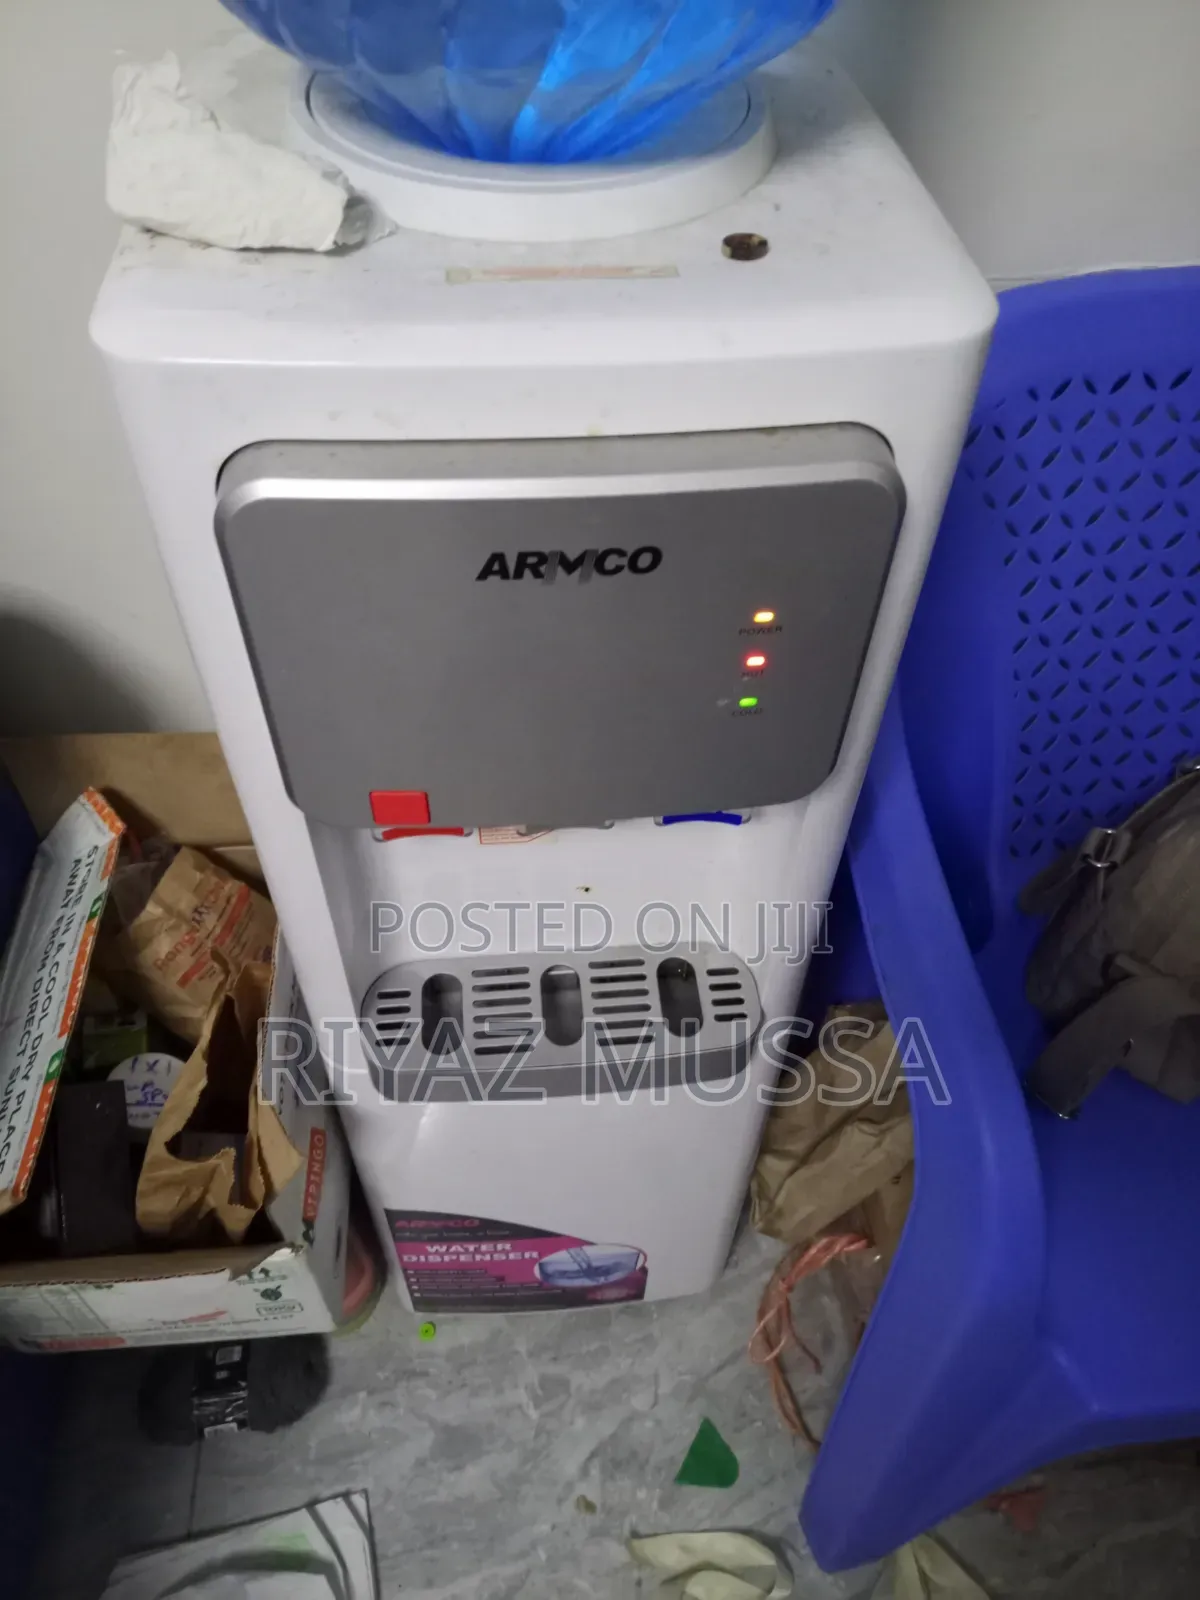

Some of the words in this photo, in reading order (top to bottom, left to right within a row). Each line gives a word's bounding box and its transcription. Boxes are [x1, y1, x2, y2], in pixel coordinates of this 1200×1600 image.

[475, 546, 663, 585] ARMCO
[738, 625, 783, 636] POWER
[60, 858, 82, 909] AWAY
[73, 845, 99, 907] STORE
[37, 914, 64, 974] FROM
[62, 912, 76, 936] IN
[53, 942, 66, 959] A
[16, 977, 43, 1058] DIRECT
[37, 961, 60, 1031] COOL
[22, 1033, 43, 1081] DRY
[402, 1251, 540, 1263] DISPENSER
[426, 1243, 512, 1253] WATER
